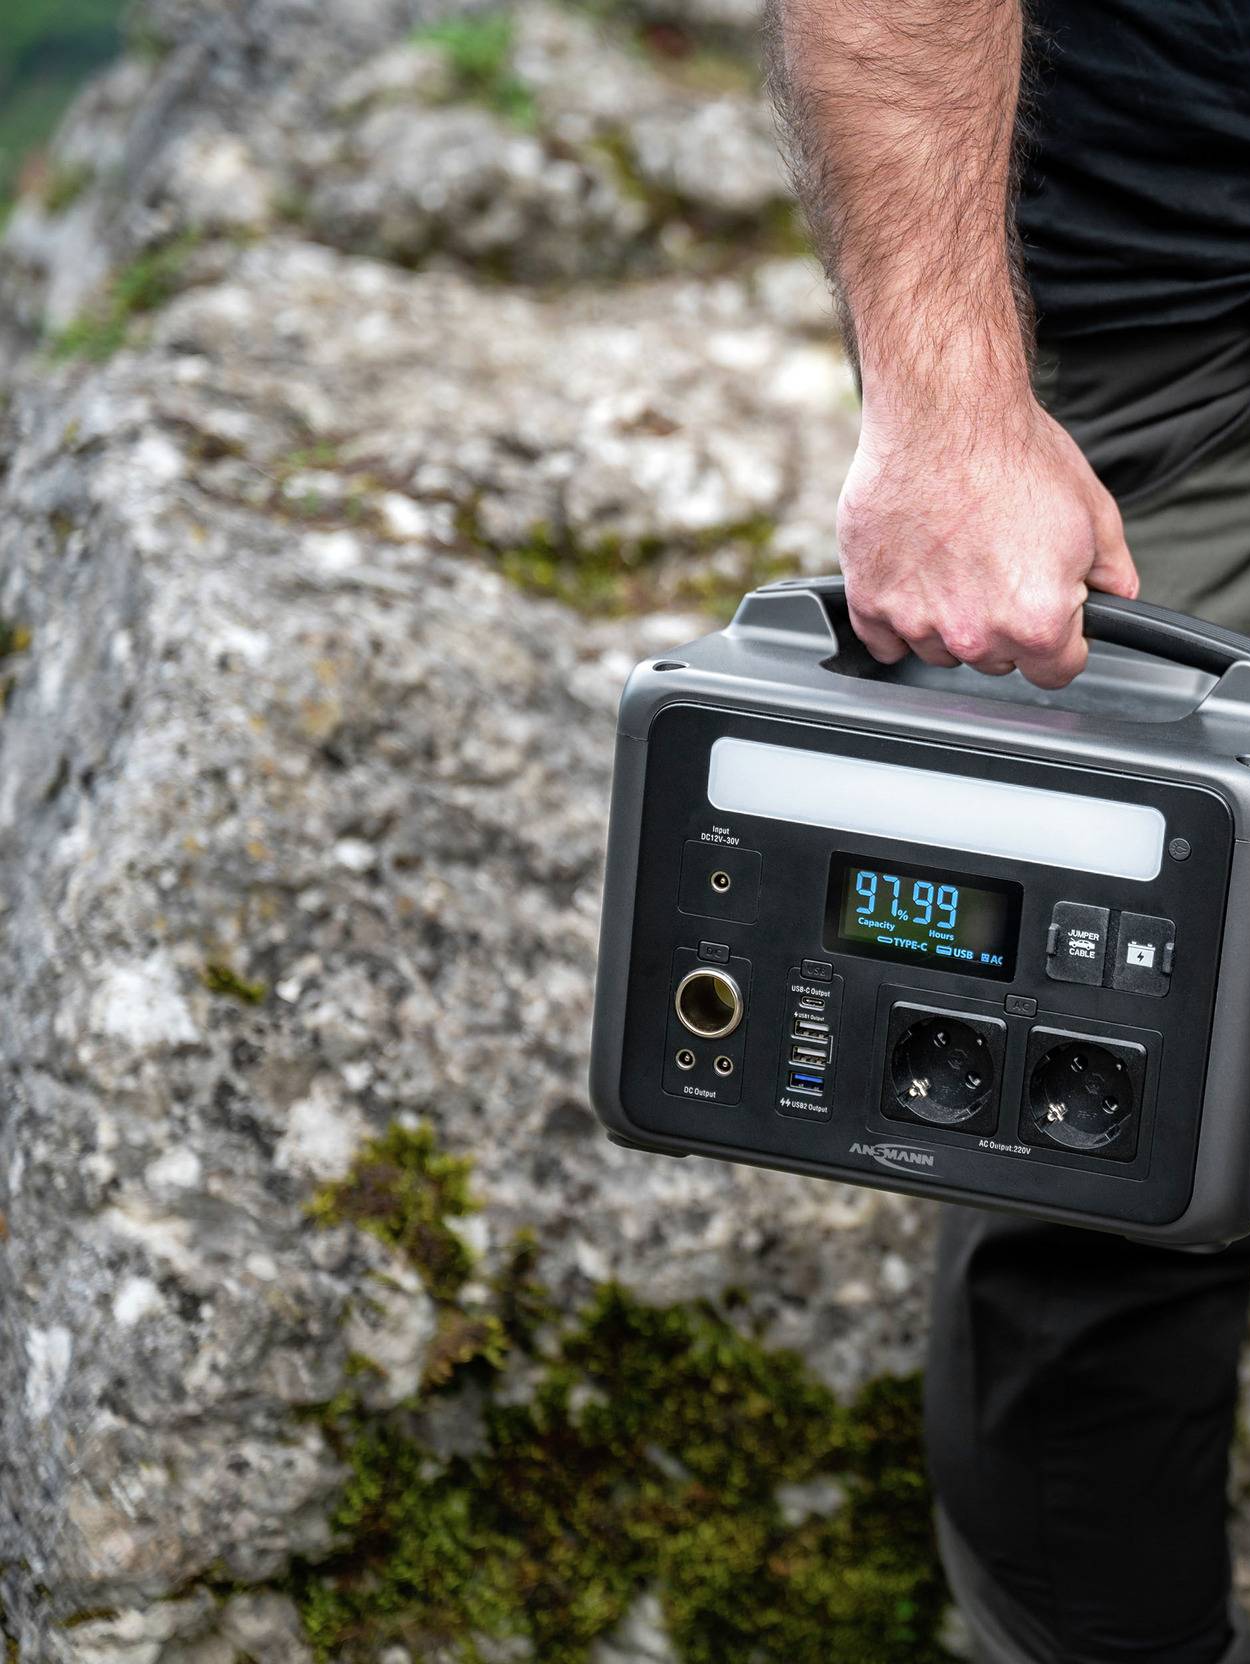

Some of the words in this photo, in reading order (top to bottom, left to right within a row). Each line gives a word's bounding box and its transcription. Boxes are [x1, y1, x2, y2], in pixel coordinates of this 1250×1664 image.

[712, 825, 730, 835] Input
[700, 832, 740, 846] DC12V-30V
[857, 917, 896, 932] Capacity
[928, 929, 955, 941] Hours
[1067, 929, 1100, 941] JUMPER
[893, 937, 928, 952] TYPE-C
[953, 947, 974, 960] USB
[1068, 947, 1096, 959] CABLE
[791, 985, 810, 994] USB-C
[810, 987, 831, 997] Output
[1012, 1000, 1031, 1012] AC
[683, 1086, 694, 1095] DC
[694, 1087, 716, 1099] Output
[791, 1101, 808, 1110] USB2
[808, 1103, 828, 1114] Output
[978, 1139, 989, 1148] AC
[848, 1142, 934, 1167] ANSMANN
